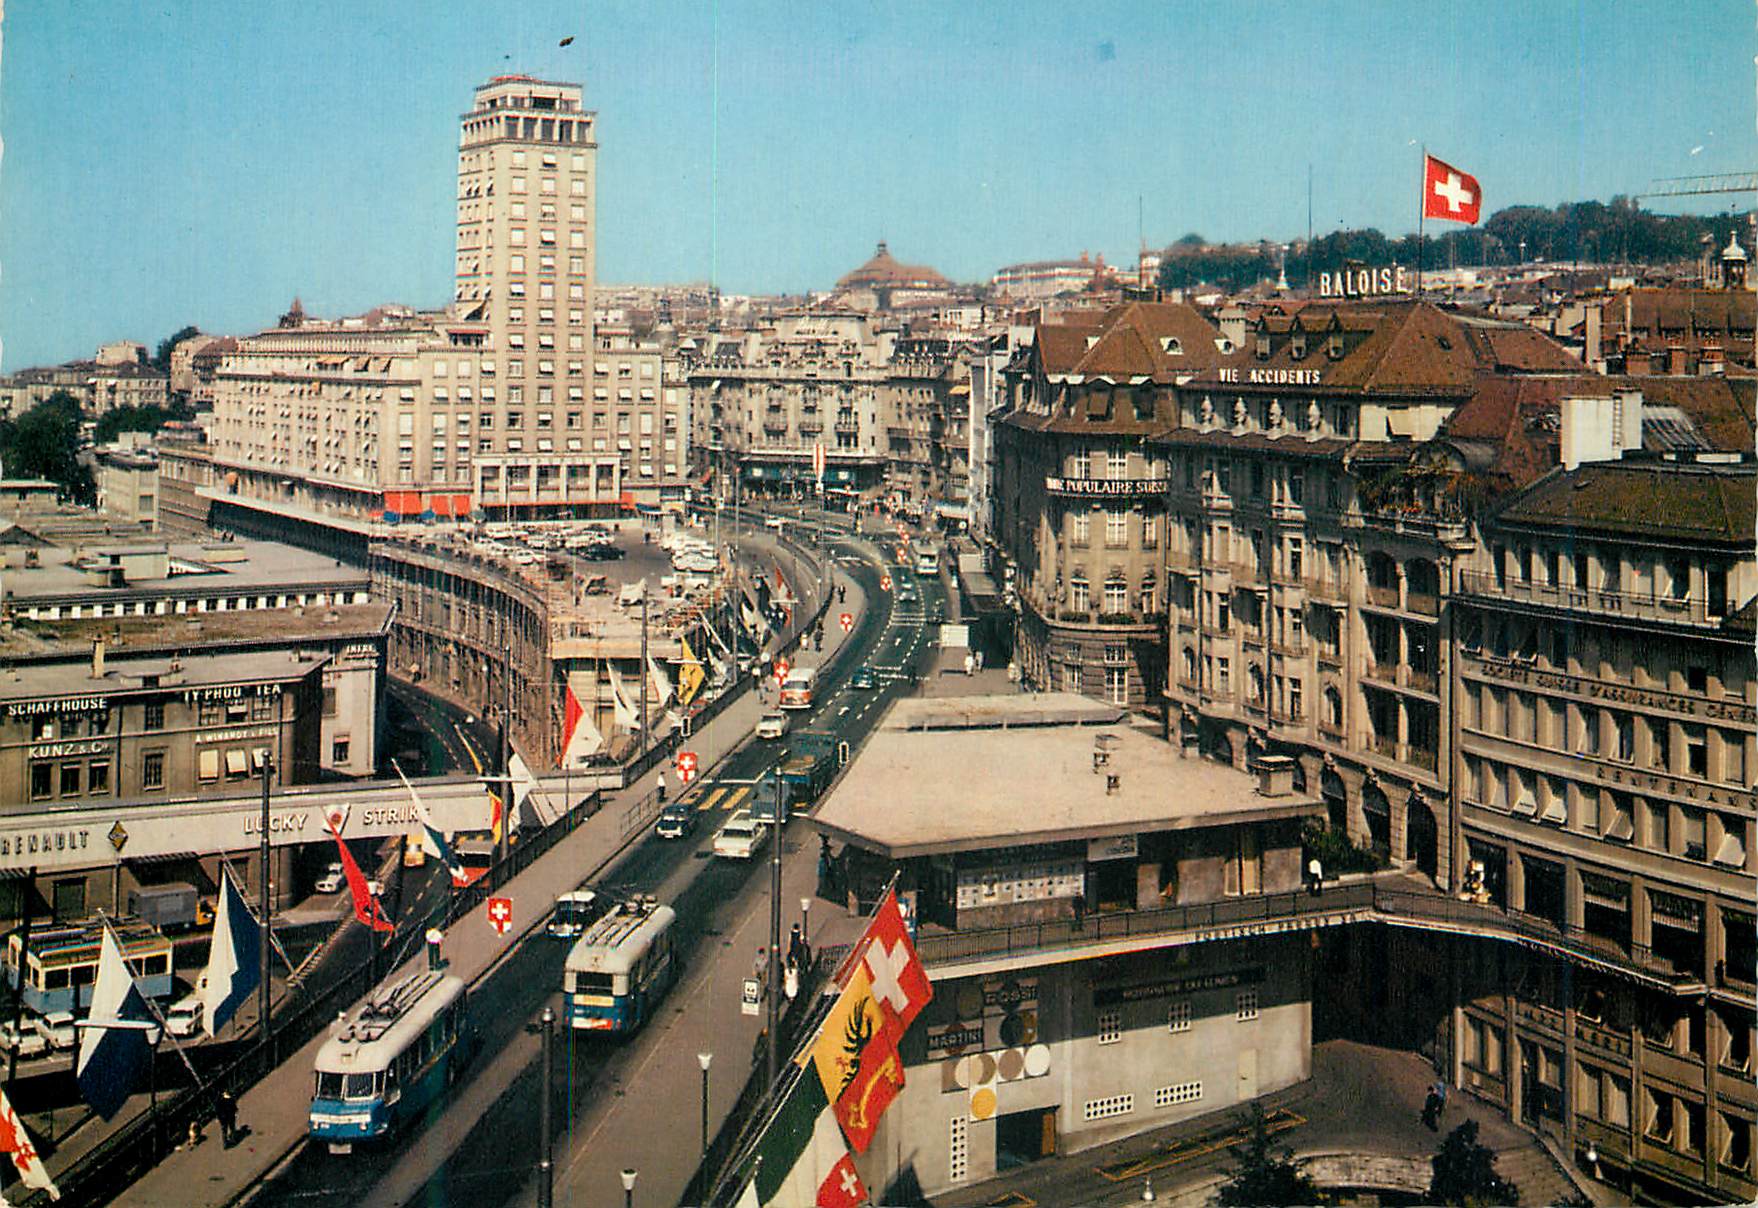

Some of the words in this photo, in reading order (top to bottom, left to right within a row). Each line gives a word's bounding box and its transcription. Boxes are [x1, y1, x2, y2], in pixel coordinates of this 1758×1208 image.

[1320, 266, 1408, 296] BALOISE
[1219, 367, 1239, 383] VIE
[1249, 368, 1320, 384] ACCIDENTS
[1066, 480, 1133, 494] POPULAIRE
[256, 684, 281, 697] TEA
[8, 698, 108, 716] SCHAFFHOUSE
[29, 743, 74, 759] KUNZ
[244, 813, 308, 834] LUCKY
[364, 805, 430, 825] STRIK
[1, 829, 89, 855] RENAULT
